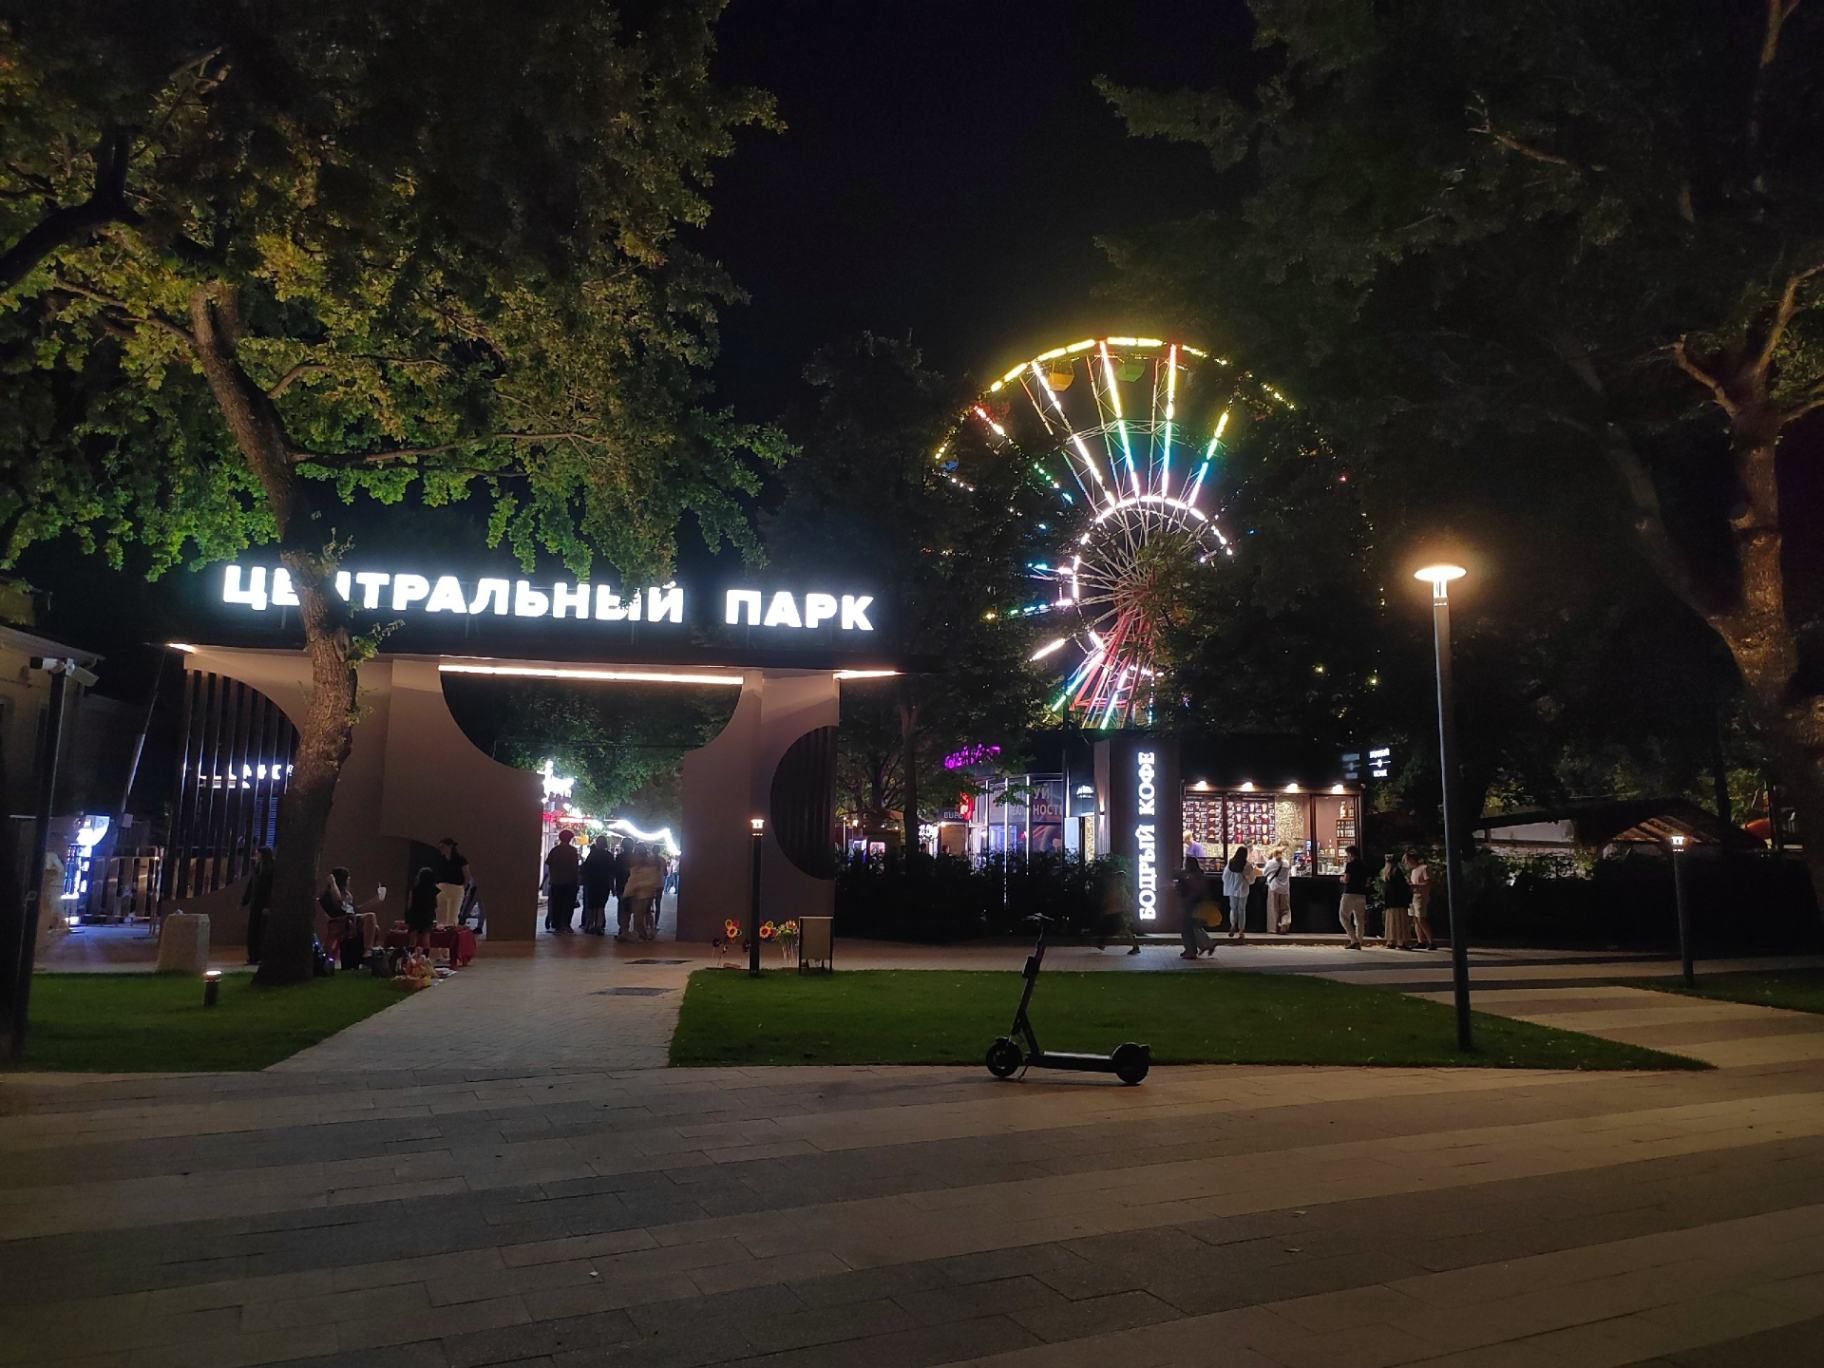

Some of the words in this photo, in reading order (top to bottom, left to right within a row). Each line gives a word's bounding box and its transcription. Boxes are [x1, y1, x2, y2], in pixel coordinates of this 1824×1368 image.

[725, 589, 874, 631] ПАРК
[1137, 751, 1155, 816] КОФЕ
[1134, 824, 1158, 921] БОДРЫЙ
